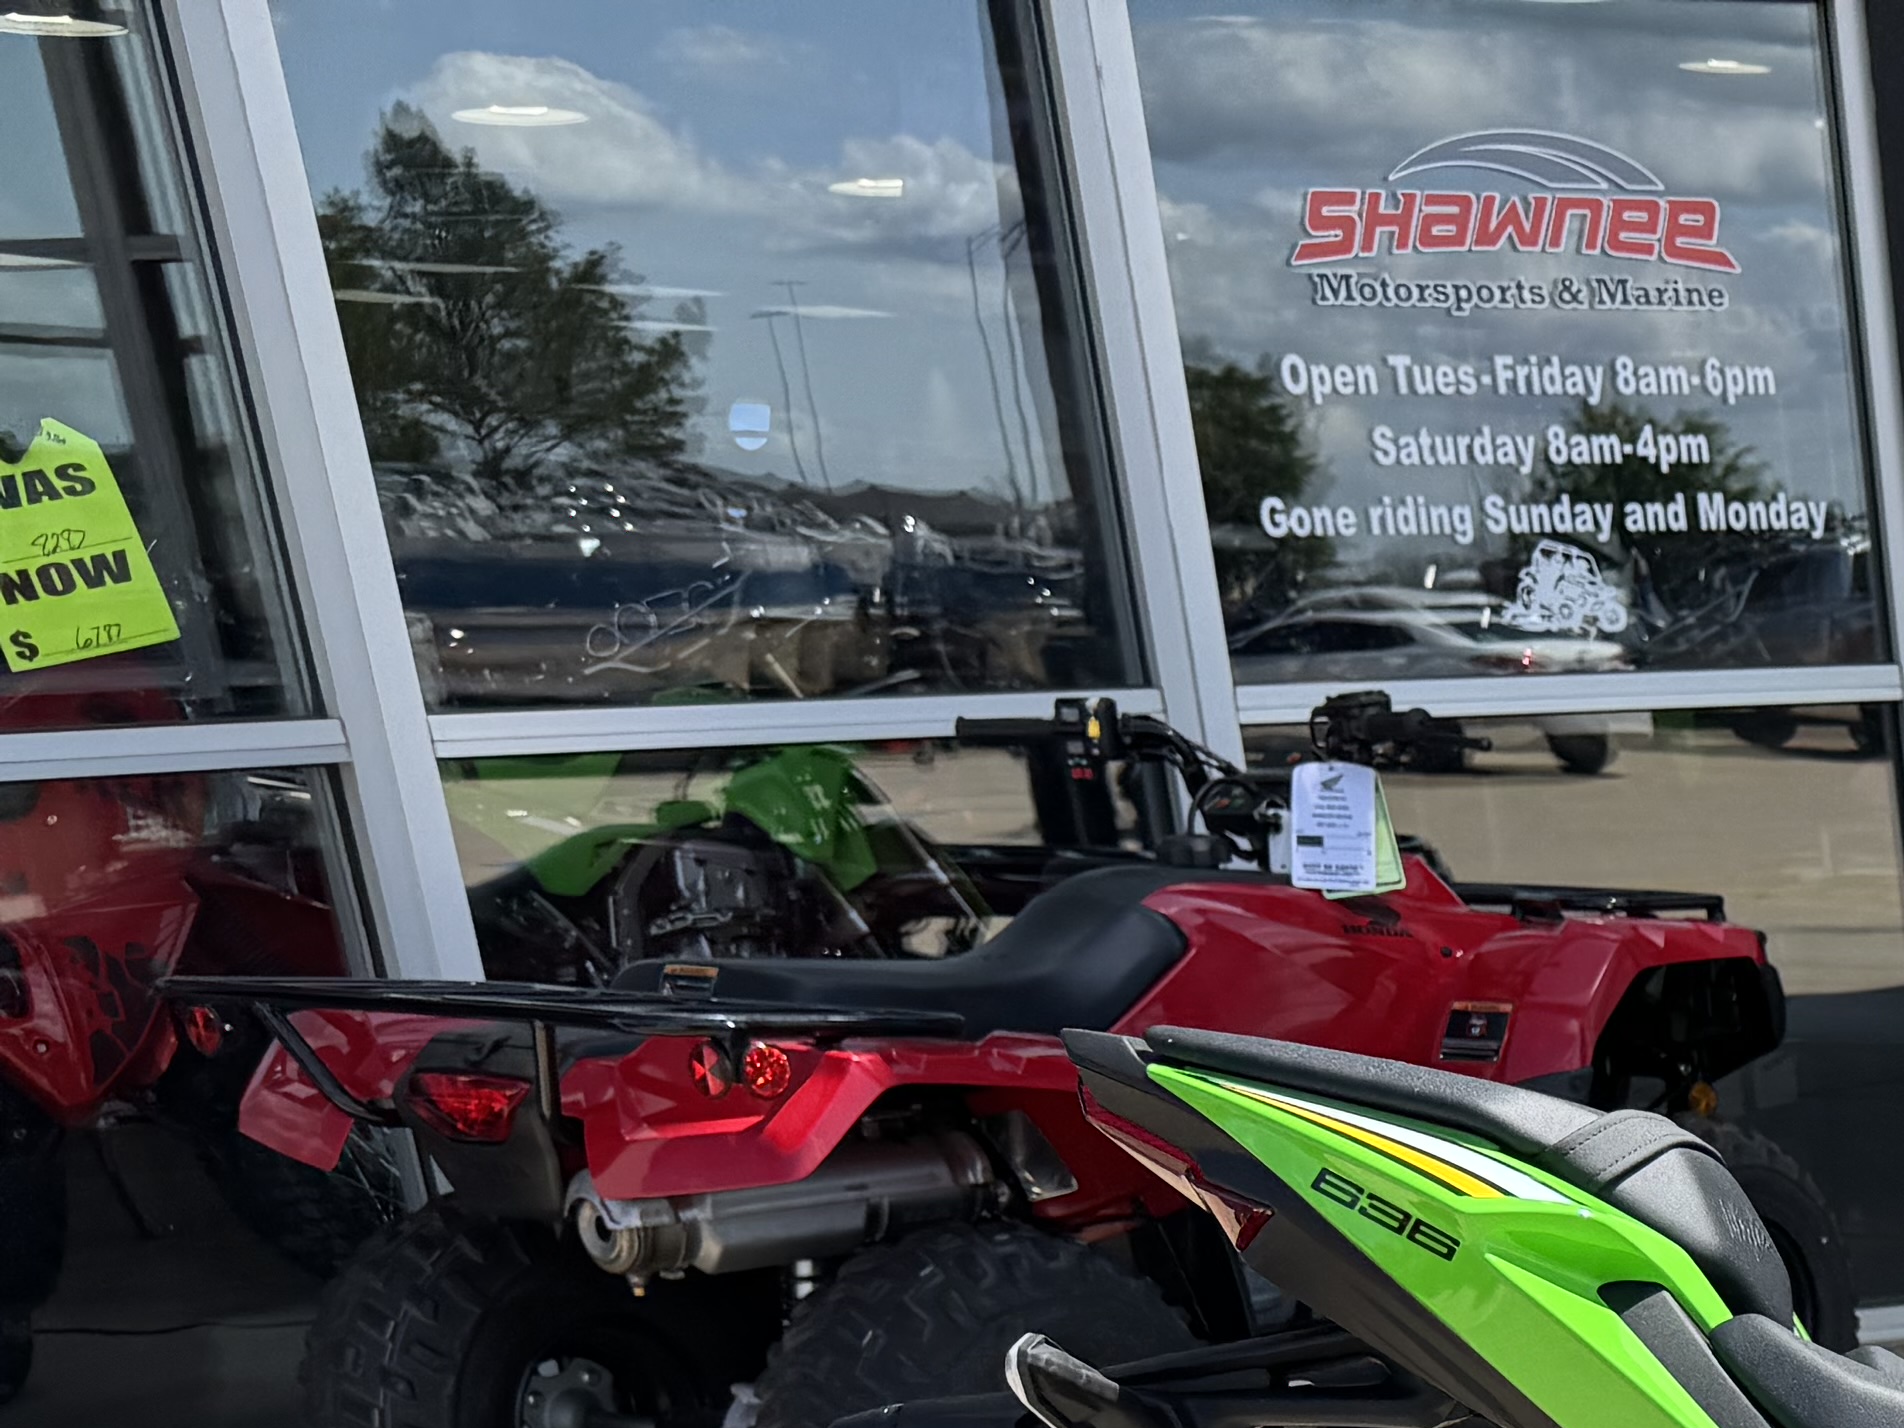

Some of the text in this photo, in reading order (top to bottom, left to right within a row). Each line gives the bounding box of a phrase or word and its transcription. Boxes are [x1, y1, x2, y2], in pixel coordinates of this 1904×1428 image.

[1312, 271, 1729, 317] Motorsports & Marine
[1280, 353, 1777, 405] Open Tues-Friday 8am-6pm
[1371, 423, 1710, 474] Saturday 8am-4pm
[1260, 492, 1828, 545] Gone riding Sunday and Monday
[0, 548, 133, 606] NOW
[9, 629, 40, 662] $
[1311, 1167, 1461, 1262] 636
